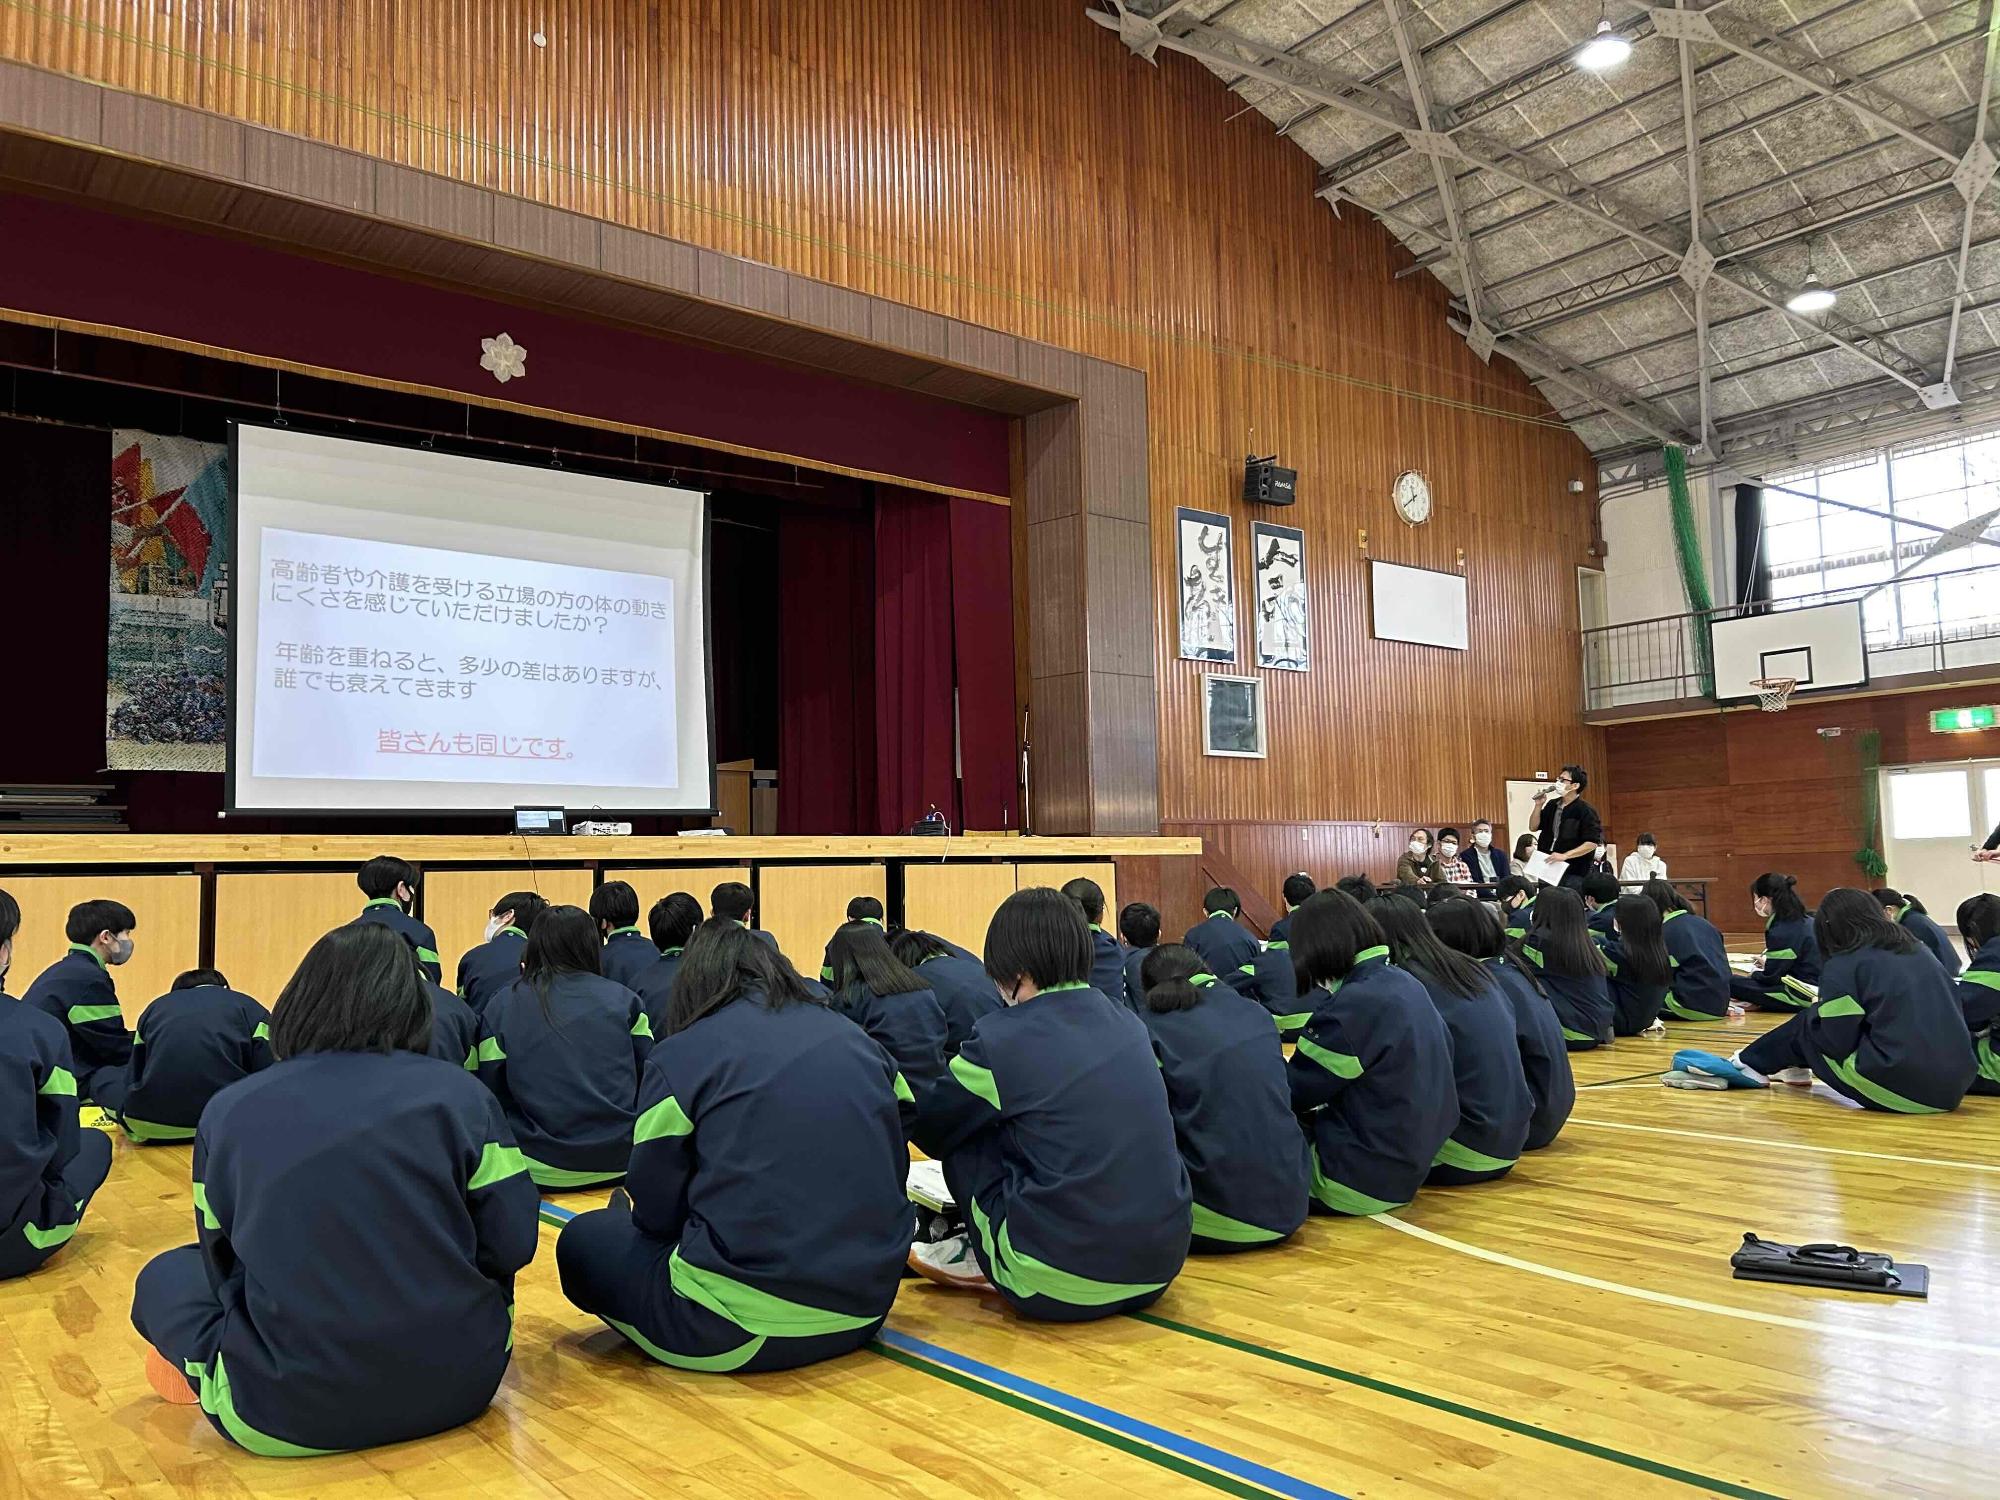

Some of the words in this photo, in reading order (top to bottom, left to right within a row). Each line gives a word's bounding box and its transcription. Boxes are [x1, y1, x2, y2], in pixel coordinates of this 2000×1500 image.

[271, 559, 667, 620] 高齢者や介護を受ける立場の方の体の動き
[274, 667, 478, 699] 誰でも衰えてきます
[275, 641, 662, 690] 年齢を重ねると、多少の差はありますが、
[376, 728, 574, 759] 皆さんも同じです。
